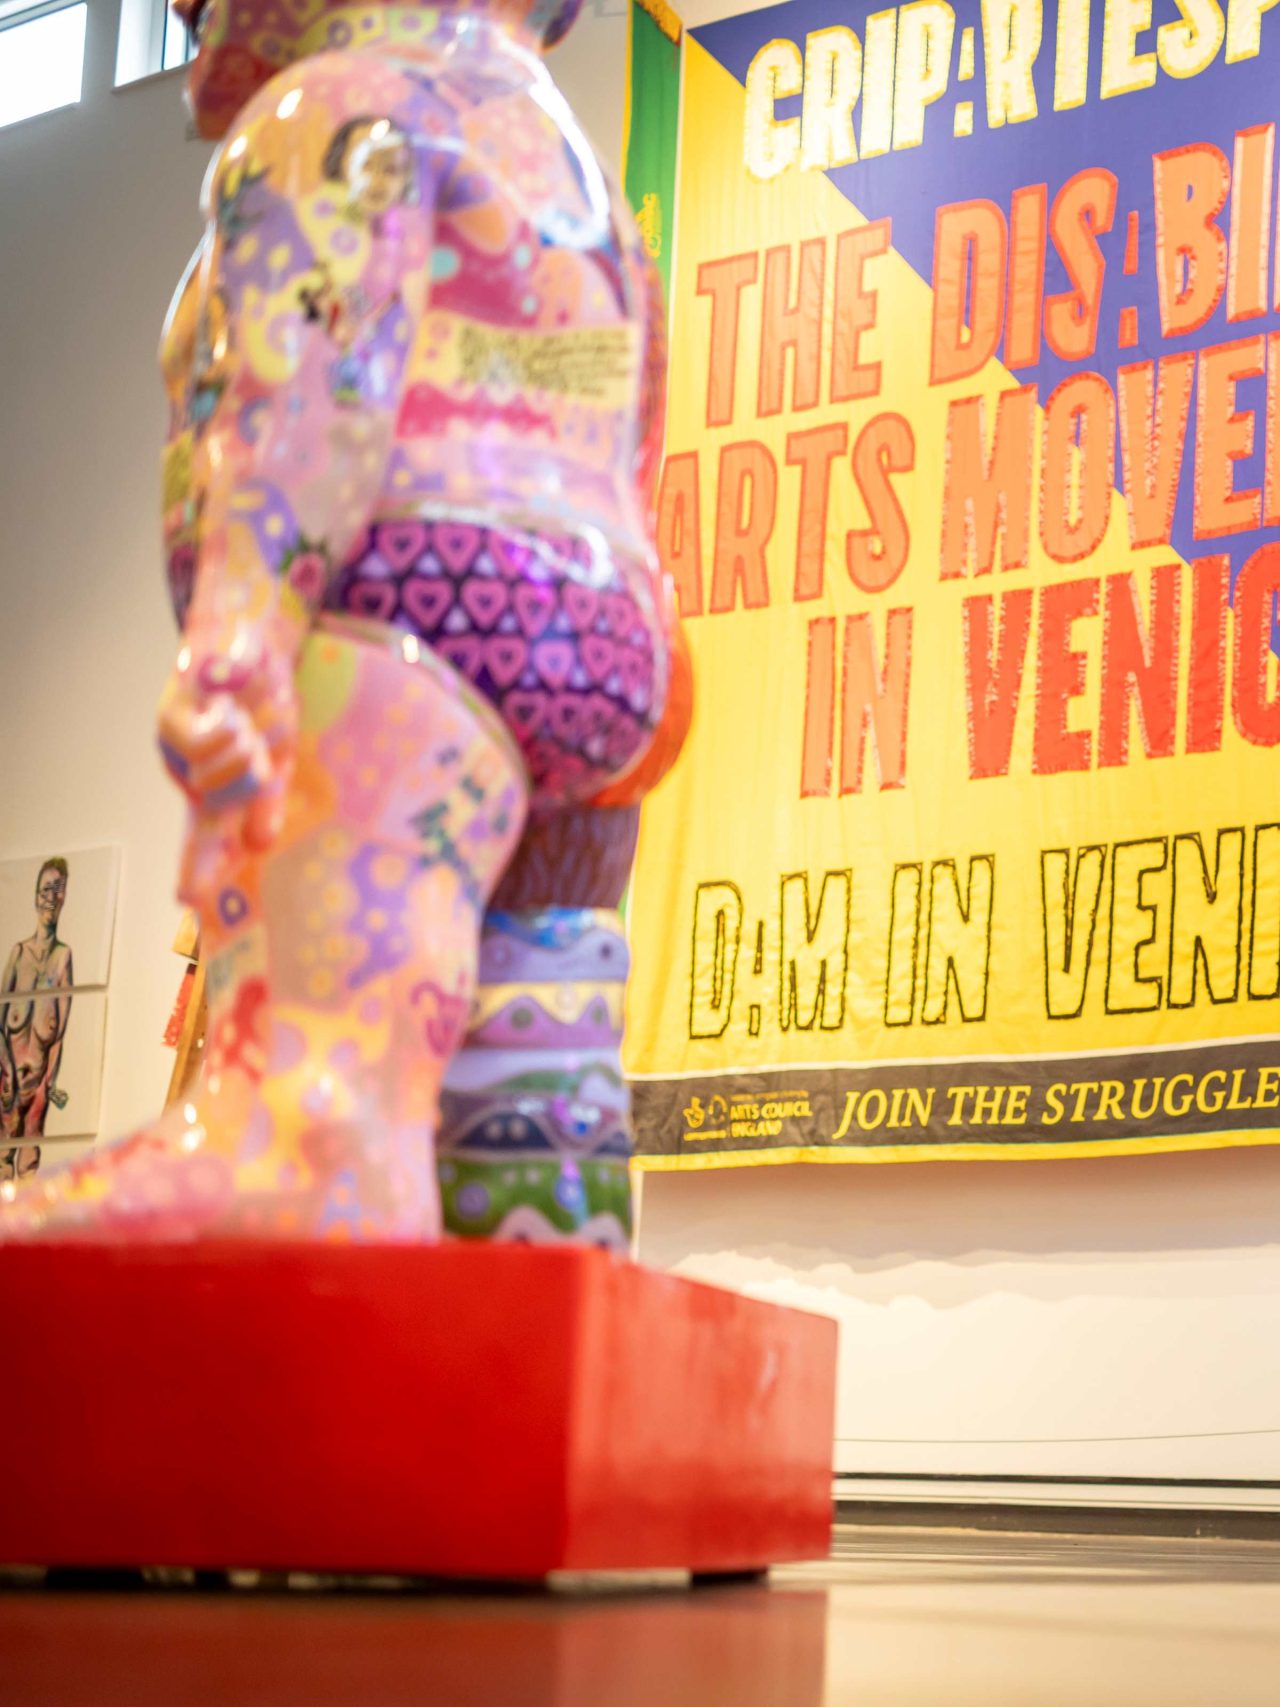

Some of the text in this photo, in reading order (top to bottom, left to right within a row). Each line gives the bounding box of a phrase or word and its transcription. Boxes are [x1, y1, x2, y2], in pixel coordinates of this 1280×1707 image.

[696, 217, 892, 429] THE
[656, 412, 915, 619] ARTS
[800, 606, 913, 800] IN
[884, 853, 995, 1027] IN
[832, 1087, 936, 1139] JOIN
[946, 1085, 1031, 1127] THE
